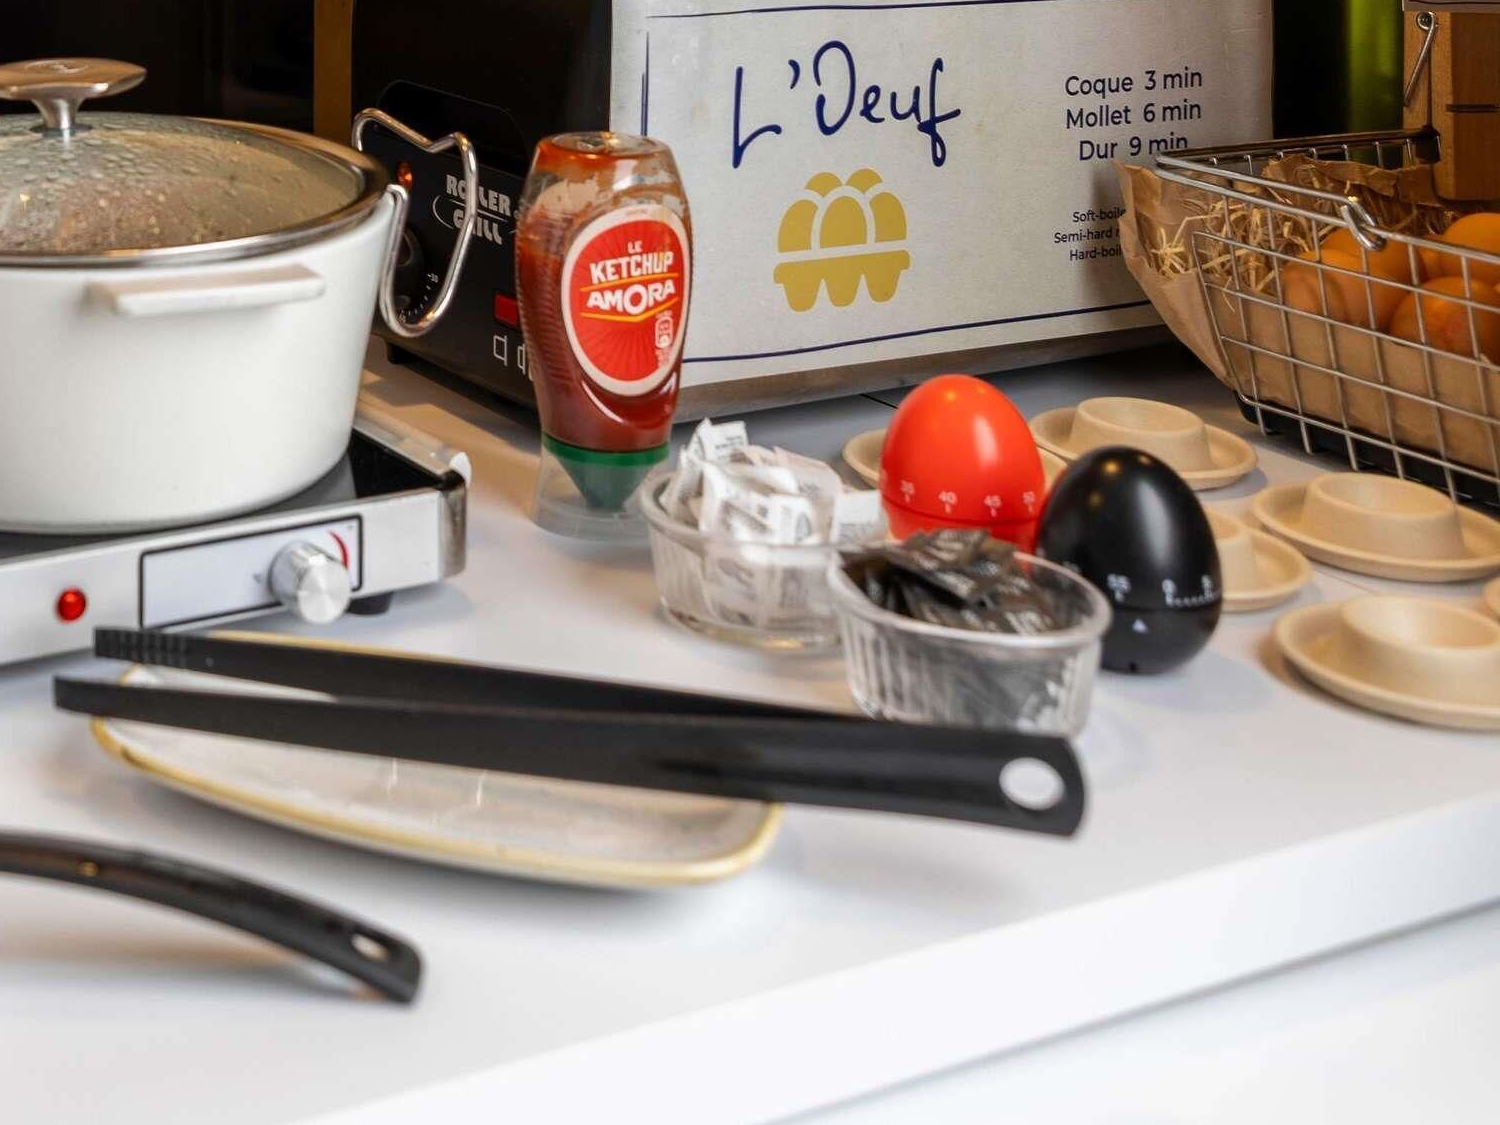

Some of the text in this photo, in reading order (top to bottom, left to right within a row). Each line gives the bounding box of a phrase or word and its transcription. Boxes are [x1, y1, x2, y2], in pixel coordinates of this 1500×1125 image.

[1064, 66, 1203, 100] Coque 3 min
[1066, 98, 1202, 129] Mollet 6 min
[1079, 131, 1189, 161] Dur 9 min
[446, 174, 512, 217] ROLER
[1072, 207, 1127, 223] Soft-boile
[627, 240, 643, 255] LE
[1053, 228, 1113, 244] Semi-hard
[1069, 239, 1123, 262] Hard-boil
[589, 250, 675, 284] KETCHUP
[586, 279, 676, 316] AMORA
